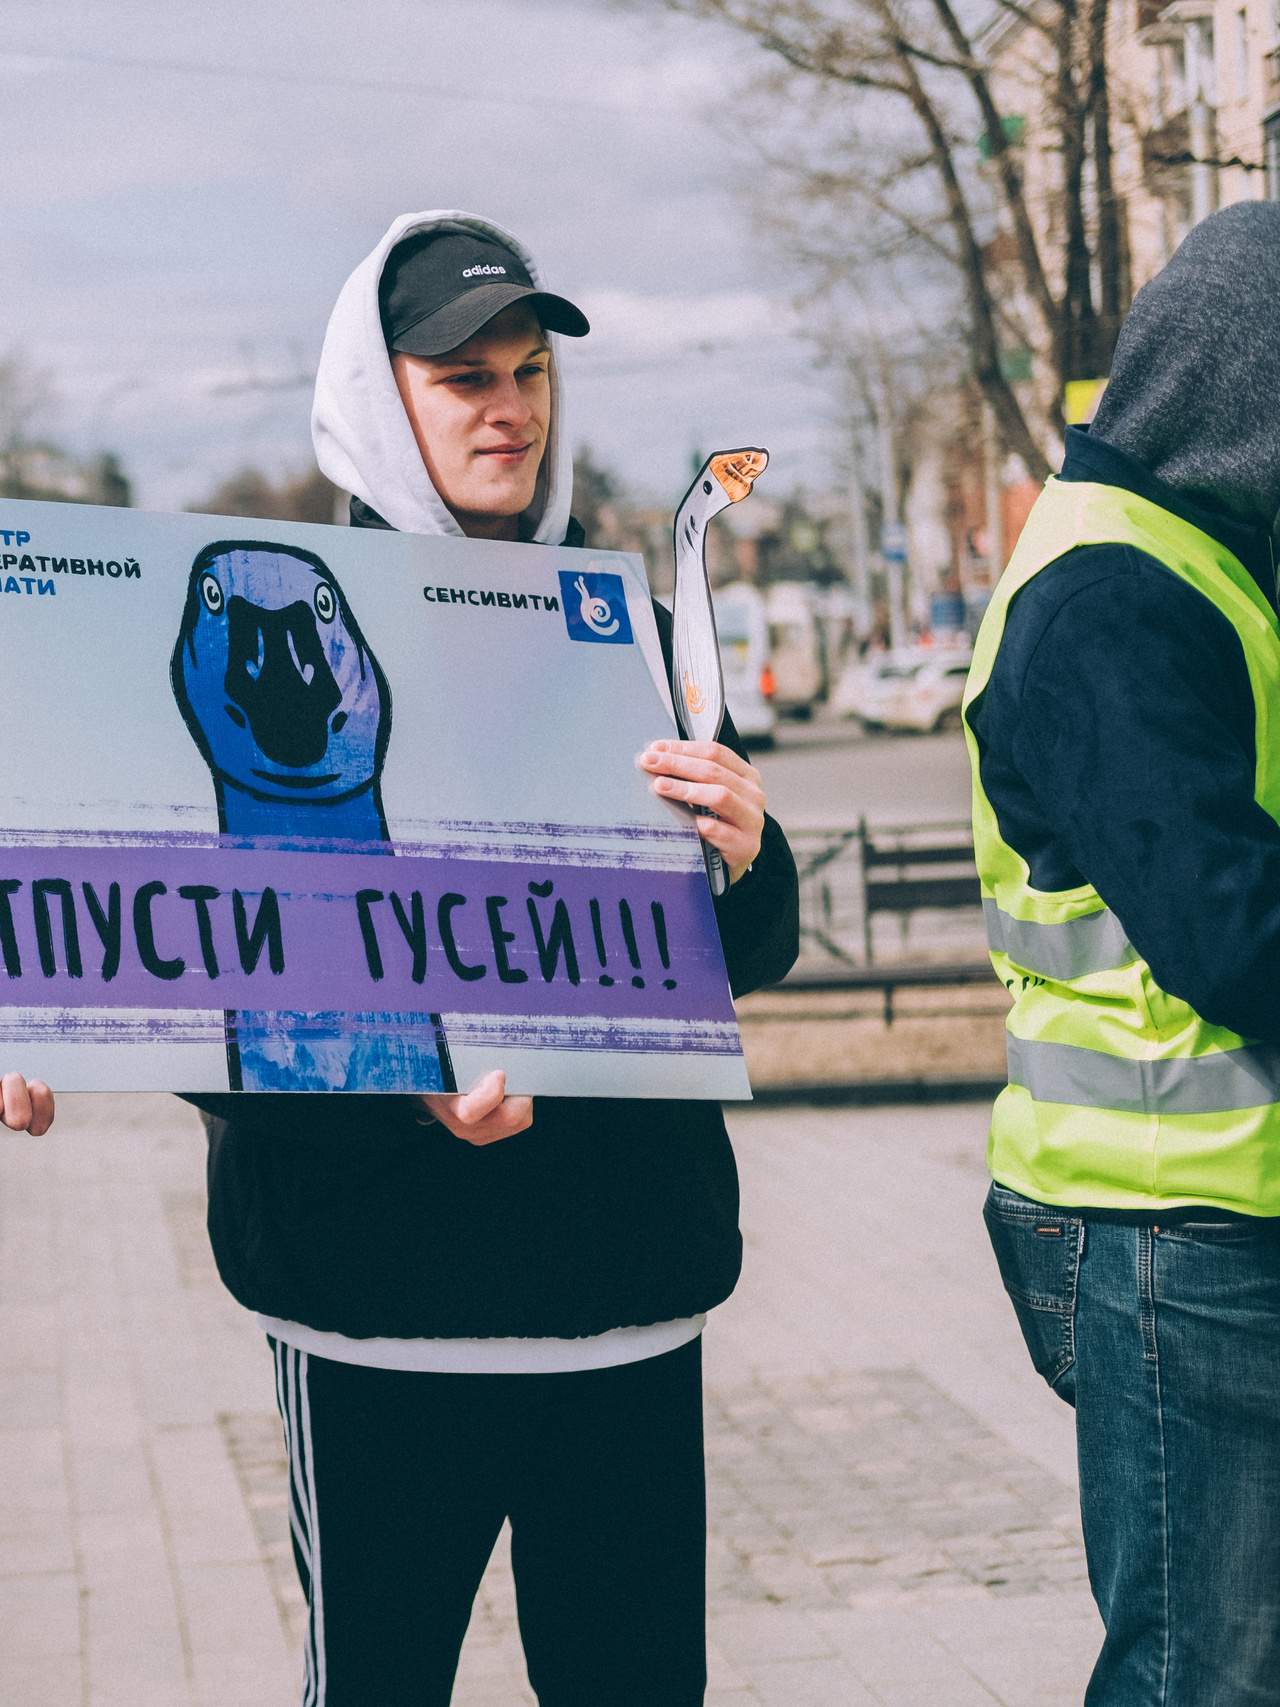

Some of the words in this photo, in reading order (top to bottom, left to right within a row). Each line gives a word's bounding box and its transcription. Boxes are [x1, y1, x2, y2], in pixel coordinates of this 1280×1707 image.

[462, 264, 506, 278] adidas
[423, 586, 560, 612] СЕНСИВИТИ
[356, 879, 677, 991] ГУСЕЙ!!!
